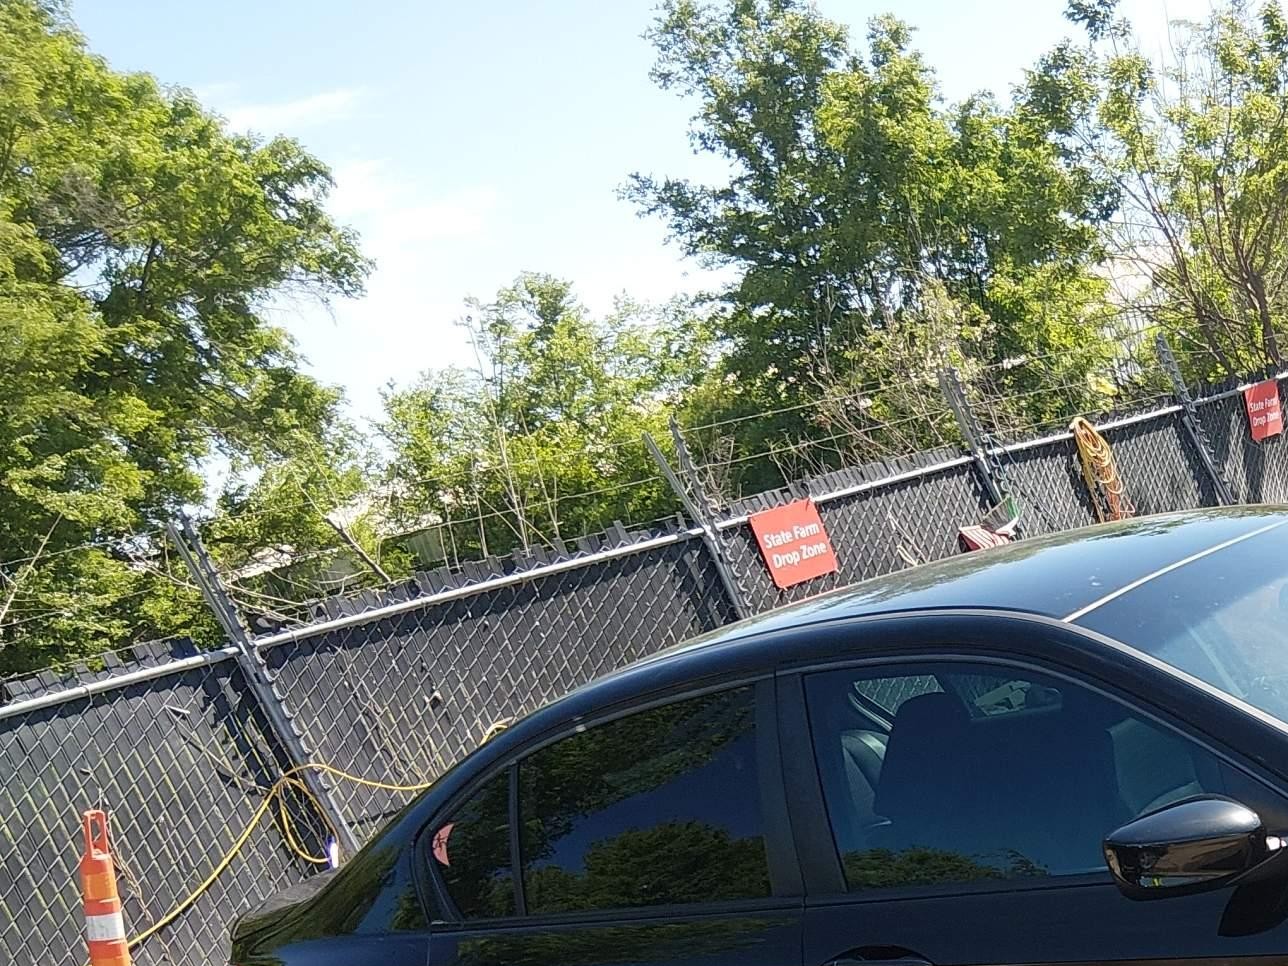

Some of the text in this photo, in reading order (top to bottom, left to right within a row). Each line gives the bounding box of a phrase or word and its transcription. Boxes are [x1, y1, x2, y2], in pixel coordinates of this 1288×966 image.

[1250, 401, 1264, 413] State
[1253, 416, 1266, 427] Drop
[763, 523, 820, 549] State Farm
[772, 542, 827, 568] Drop Zone
